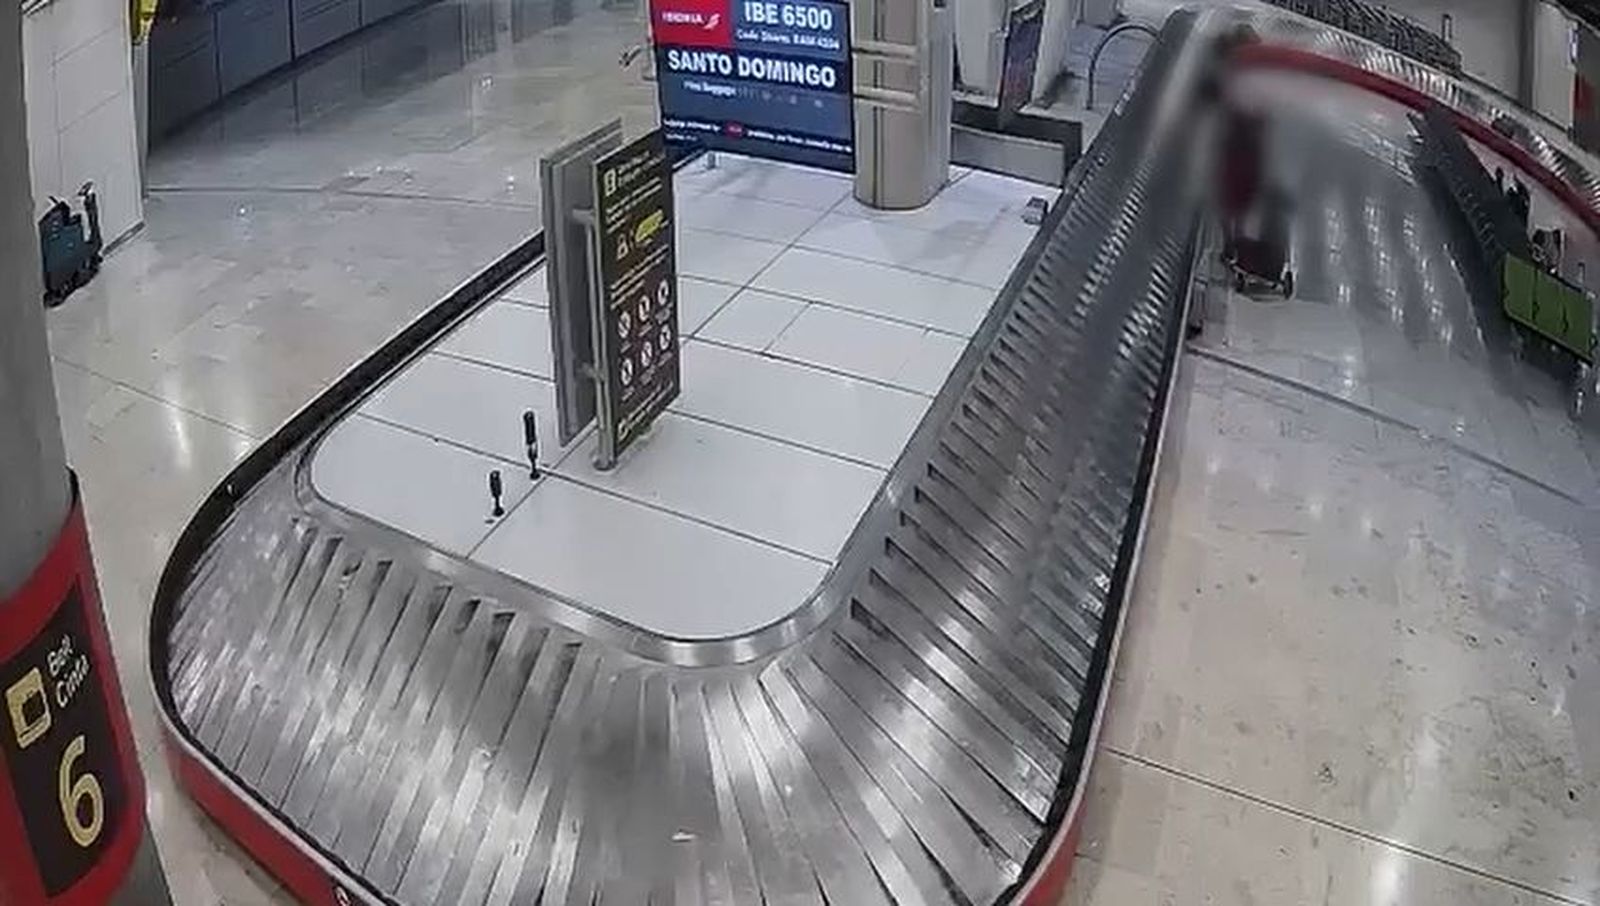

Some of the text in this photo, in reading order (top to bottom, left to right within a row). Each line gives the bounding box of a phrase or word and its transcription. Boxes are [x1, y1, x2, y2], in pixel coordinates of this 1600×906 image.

[744, 1, 832, 30] IBE 6500
[668, 50, 836, 87] SANTO DOMINGO
[56, 654, 90, 708] Cinta
[59, 734, 104, 848] 6
